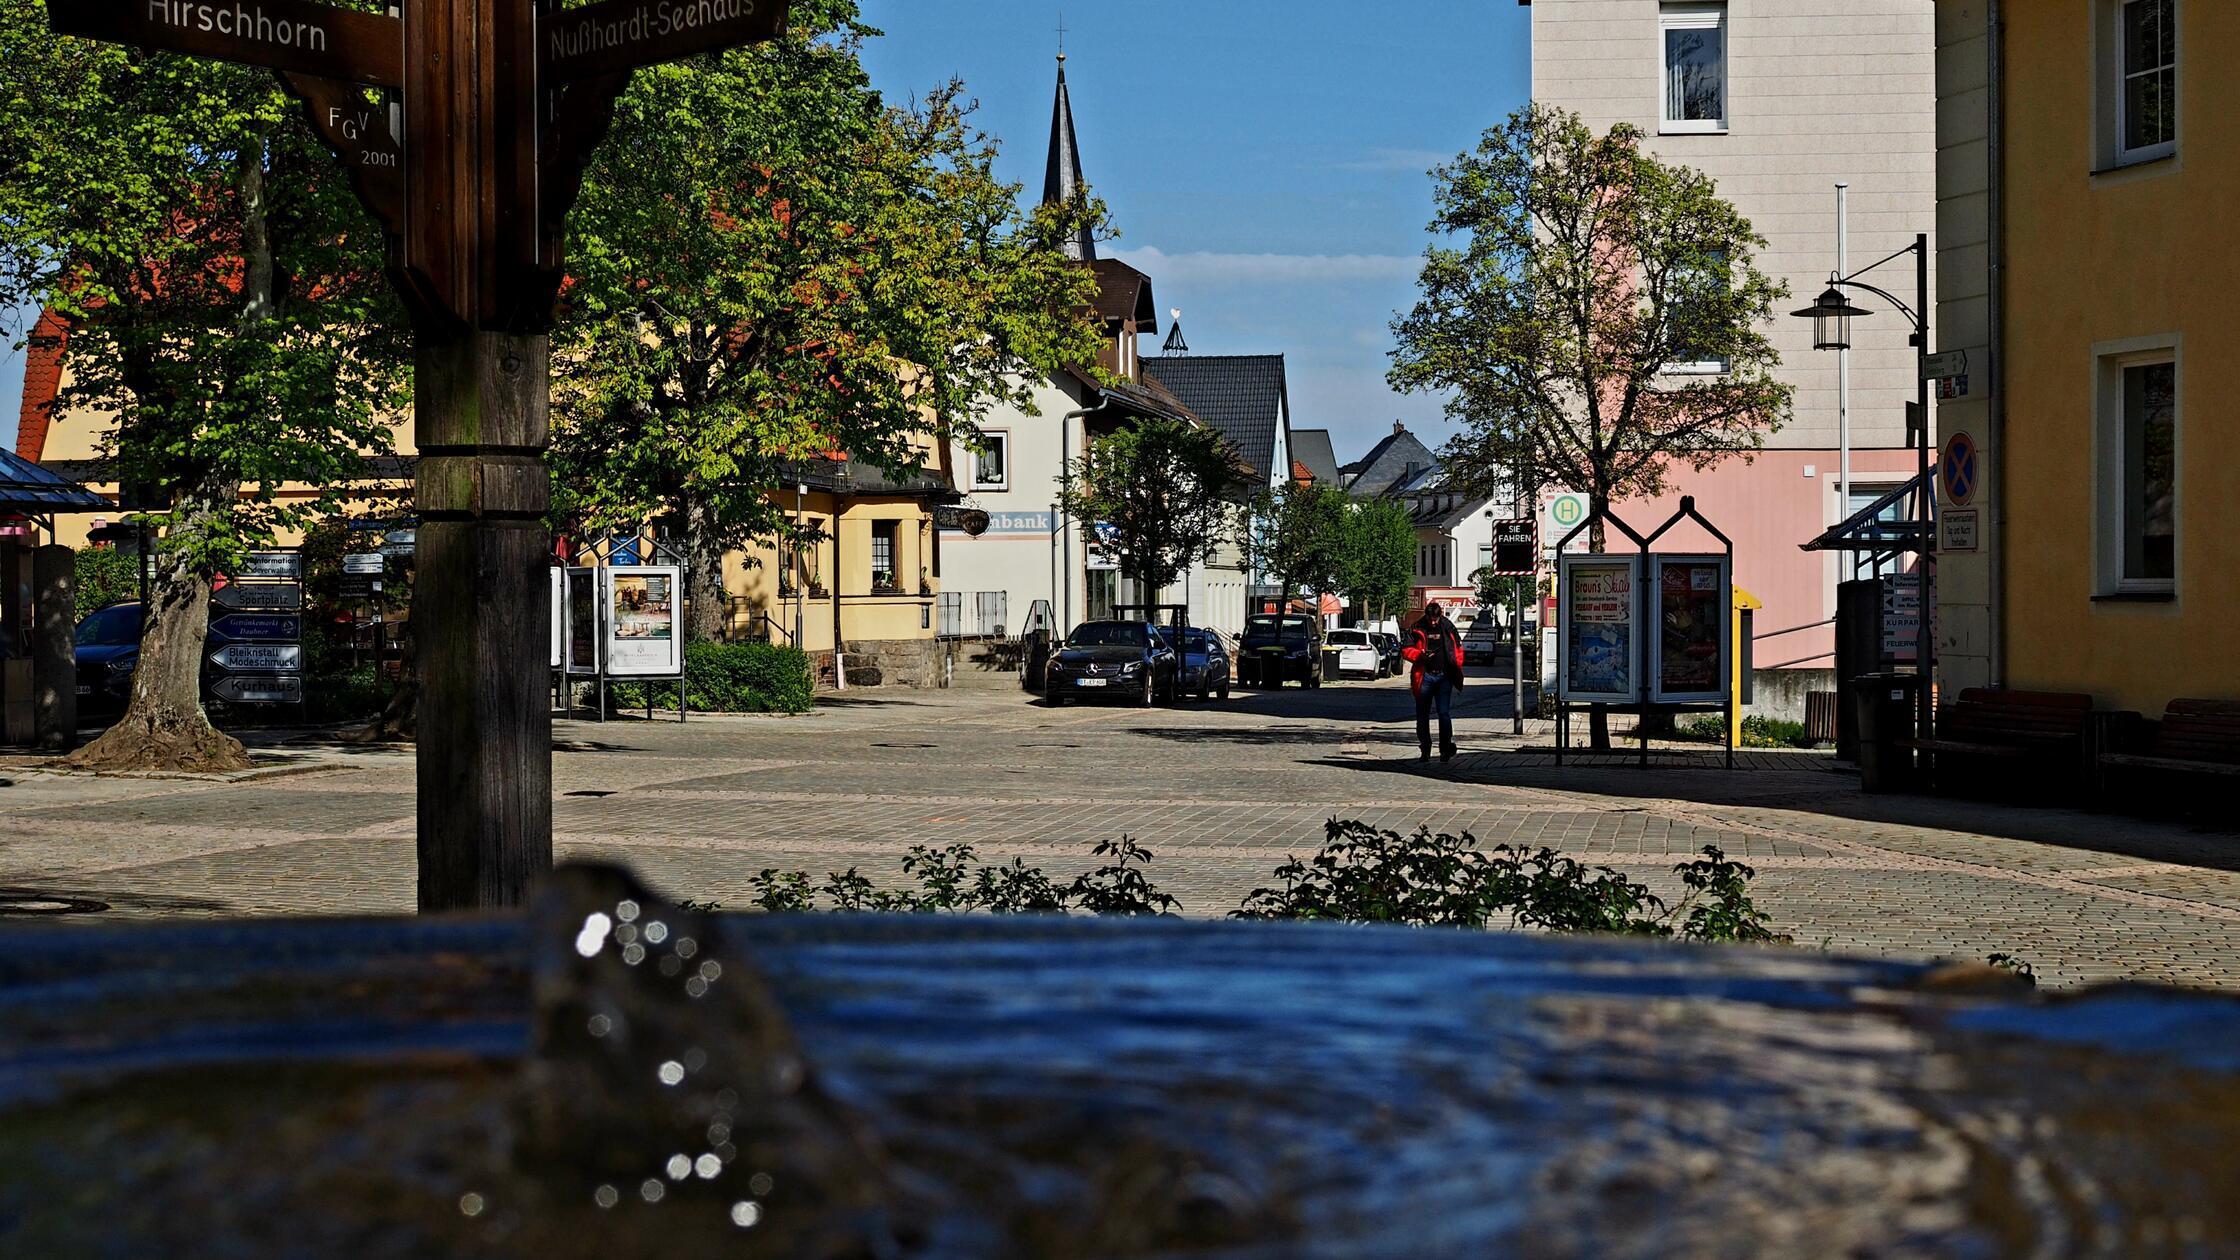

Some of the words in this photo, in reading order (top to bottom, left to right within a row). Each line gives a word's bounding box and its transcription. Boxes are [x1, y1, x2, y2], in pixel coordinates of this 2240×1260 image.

[149, 0, 326, 51] Hirschhorn
[551, 0, 754, 61] Nußhardt-Seehaus
[361, 150, 396, 168] 2001
[1508, 525, 1521, 533] SIE
[1498, 534, 1532, 543] FAHREN
[1575, 580, 1602, 593] Braun's
[239, 595, 289, 606] Sportplatz
[229, 647, 279, 657] Bleikristall
[229, 657, 296, 667] Modeschmuck
[231, 680, 296, 692] Kurhaus
